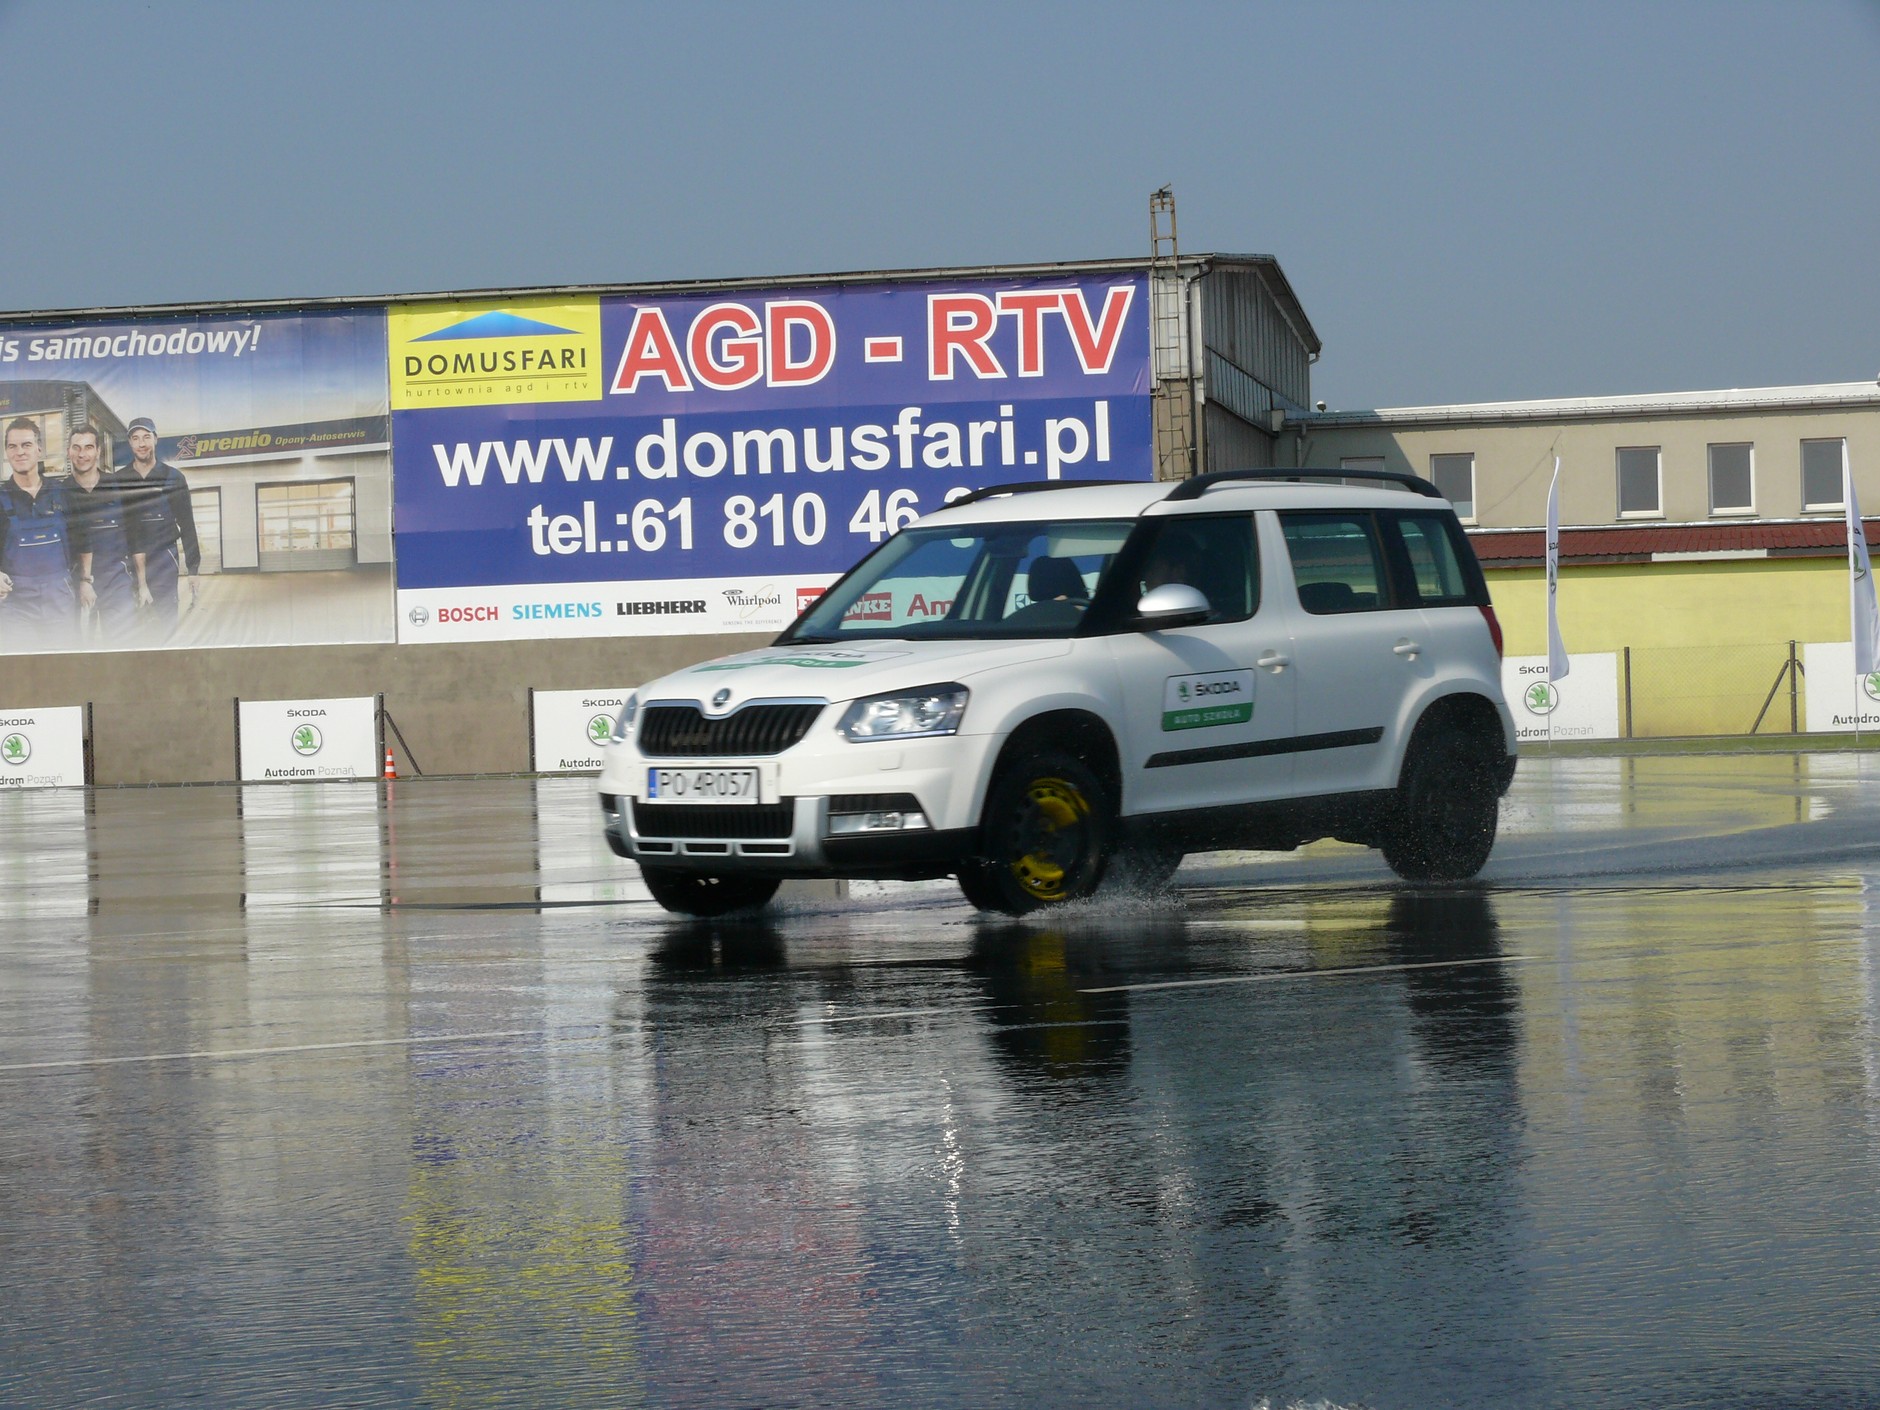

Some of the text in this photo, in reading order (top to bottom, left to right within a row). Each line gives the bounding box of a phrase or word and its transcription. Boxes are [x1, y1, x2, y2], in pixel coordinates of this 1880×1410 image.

[27, 325, 261, 361] samochodowy!
[609, 285, 1136, 395] AGD - RTV
[405, 348, 587, 377] DOMUSFARI
[405, 383, 493, 398] hurtownia
[505, 383, 533, 394] agd
[564, 382, 588, 390] rtv
[195, 429, 366, 457] premio Opony-Autoserwis
[432, 401, 1111, 487] www.domusfari.pl
[527, 488, 921, 556] tel.:61 810 46
[616, 600, 707, 616] LIEBHERR
[727, 594, 781, 608] Whirlpool
[438, 606, 499, 623] BOSCH
[512, 602, 603, 620] SIEMENS
[1519, 666, 1548, 675] ŠKO
[582, 699, 623, 708] ŠKODA
[287, 709, 327, 718] ŠKODA
[1832, 713, 1880, 725] Autodro
[1553, 726, 1594, 736] Poznań
[264, 765, 354, 777] Autodrom Poznań
[559, 757, 605, 769] Autodro
[660, 772, 687, 796] PO
